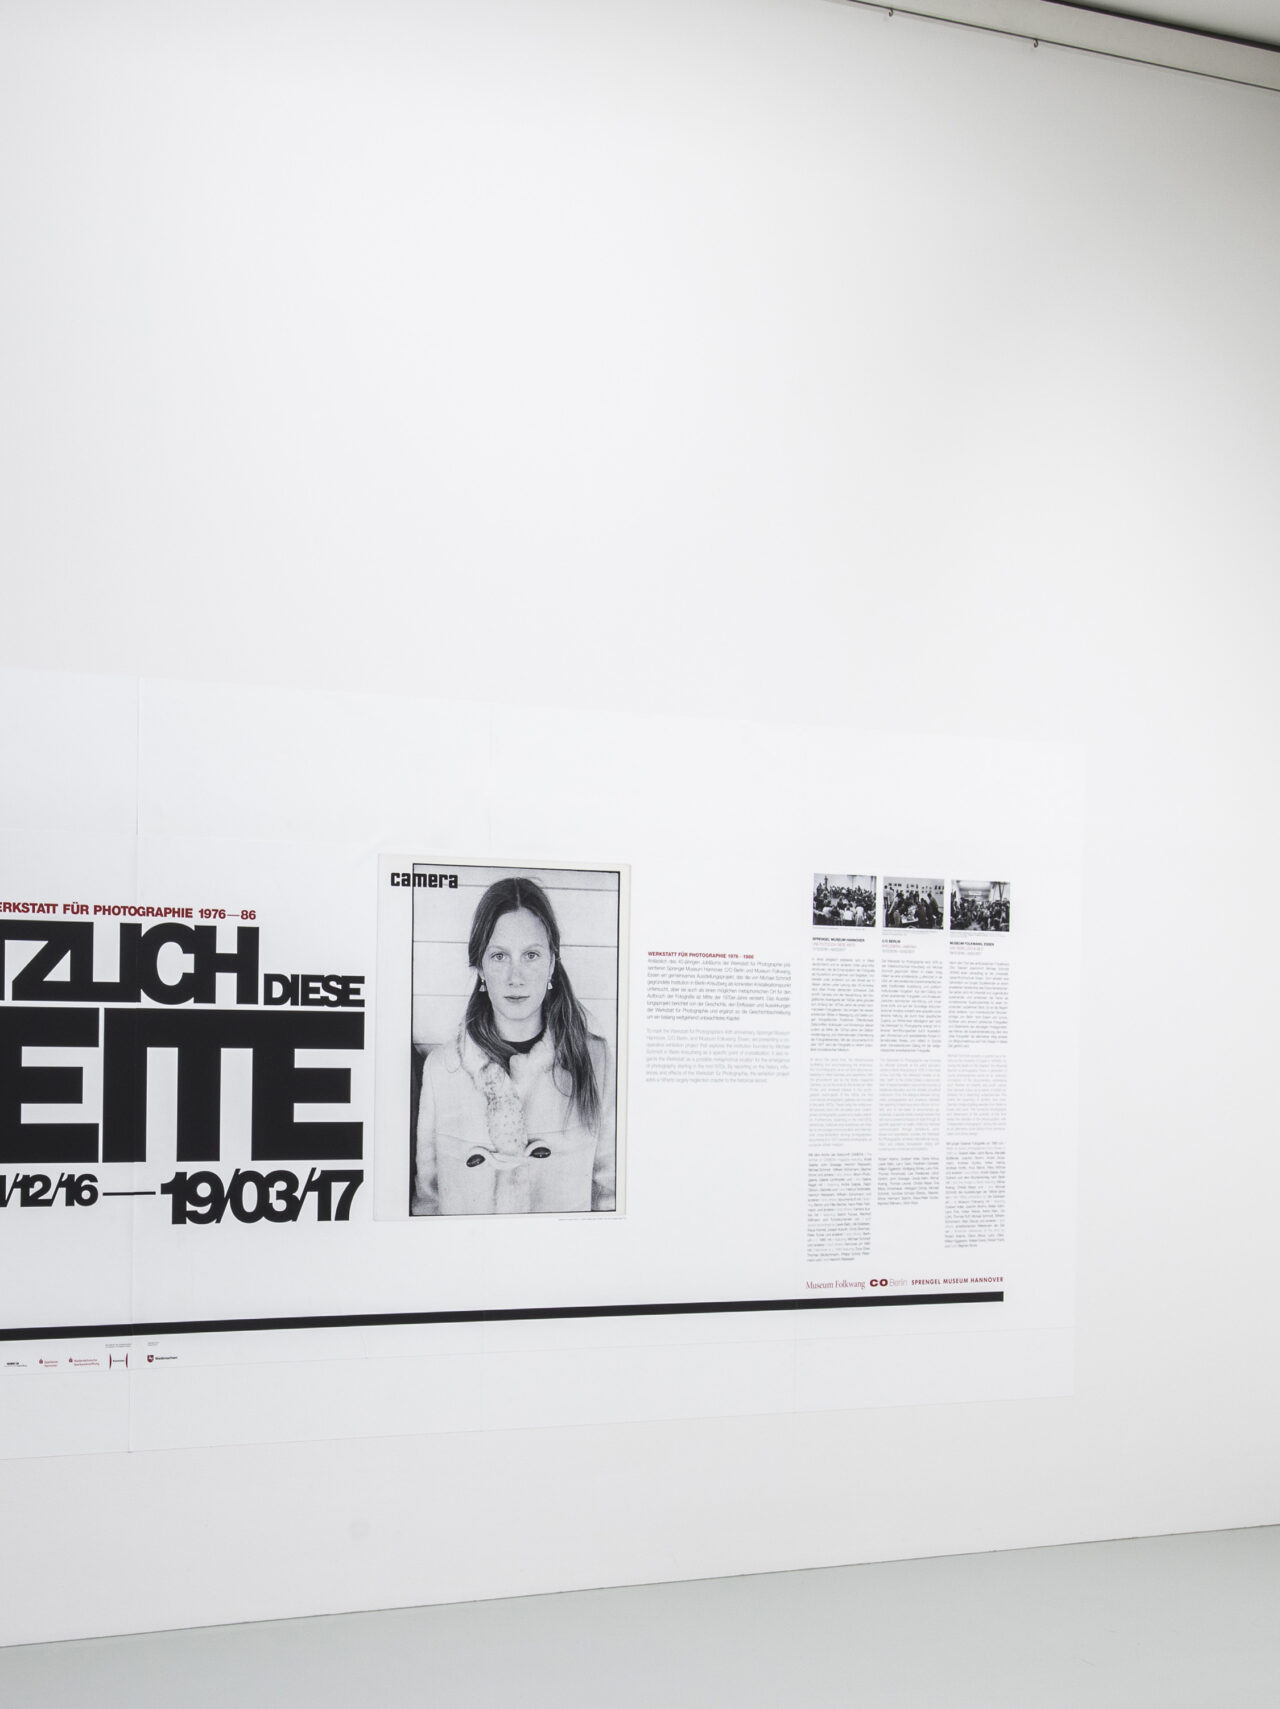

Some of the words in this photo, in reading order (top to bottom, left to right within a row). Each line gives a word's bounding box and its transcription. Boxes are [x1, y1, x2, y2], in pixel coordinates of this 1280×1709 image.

[390, 871, 459, 889] camera
[62, 901, 90, 915] FÜR
[93, 904, 194, 919] PHOTOGRAPHIE
[263, 973, 366, 1008] DIESE
[160, 1167, 364, 1225] 19/03/17
[806, 1280, 834, 1289] Museum
[835, 1279, 866, 1290] Folkwang
